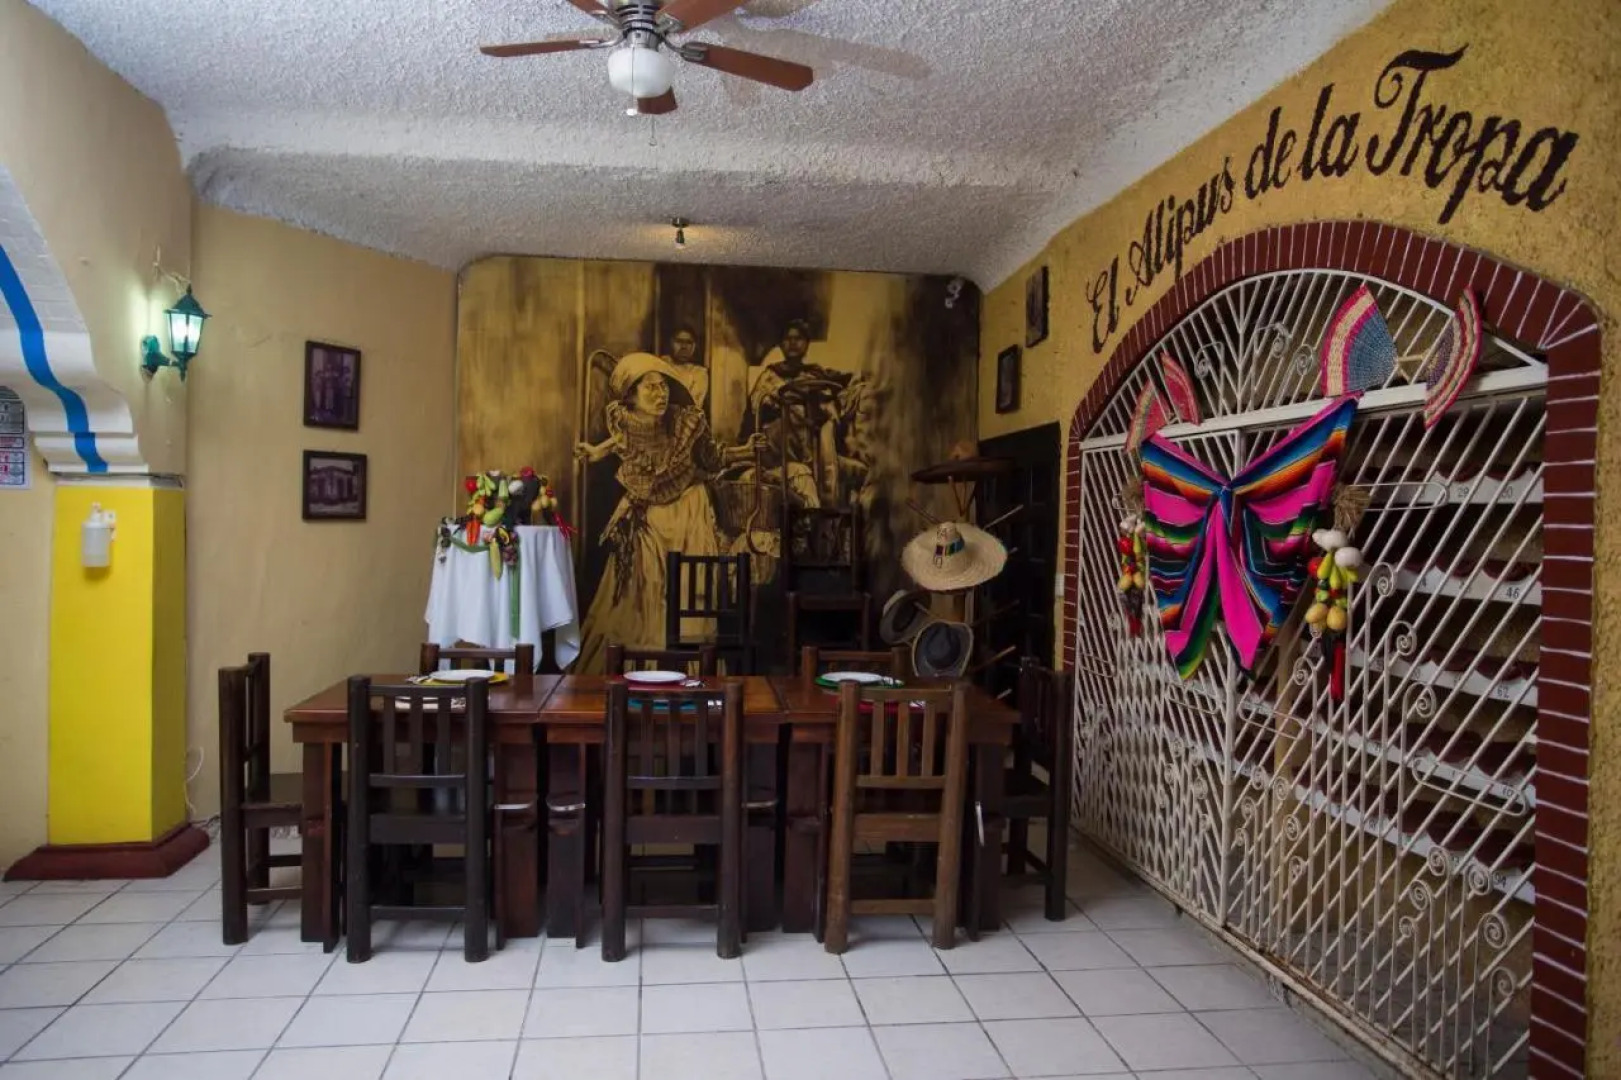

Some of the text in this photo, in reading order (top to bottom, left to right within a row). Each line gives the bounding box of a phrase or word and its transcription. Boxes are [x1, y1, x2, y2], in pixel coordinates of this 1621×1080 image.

[1086, 42, 1580, 353] El Alipus de la Tropa
